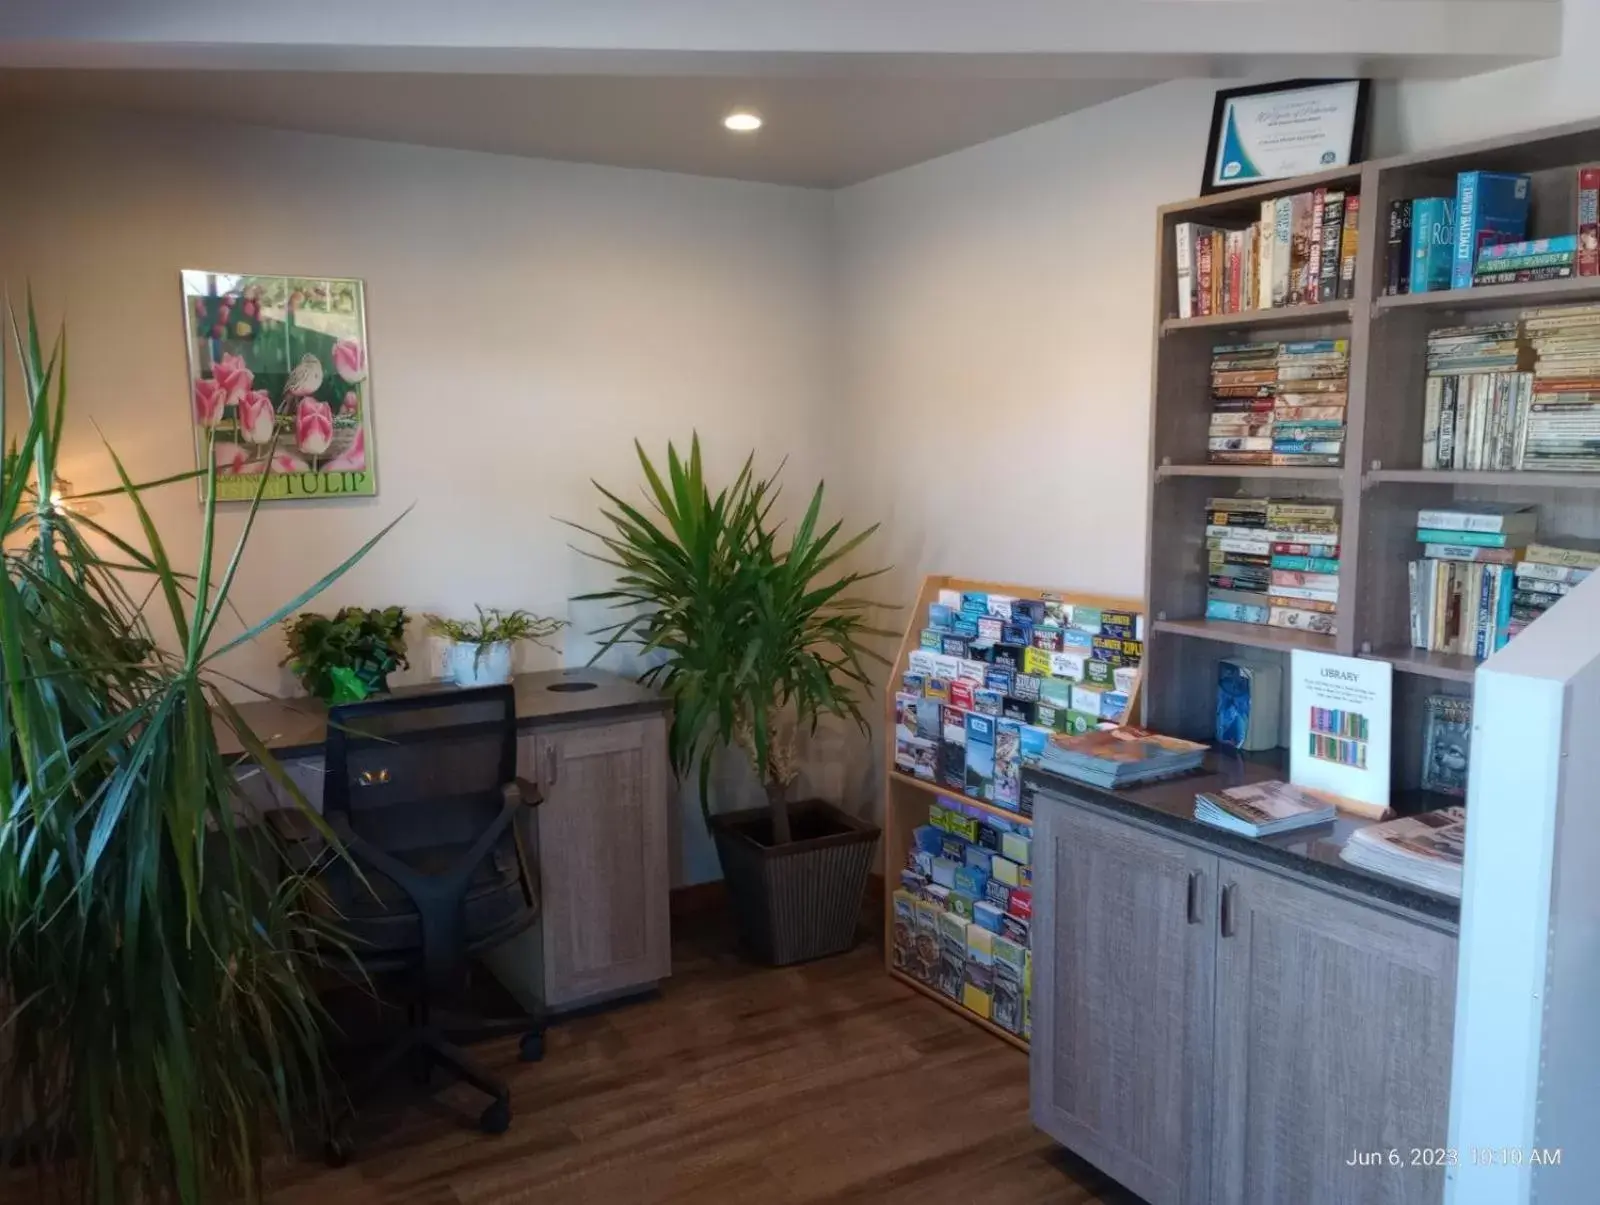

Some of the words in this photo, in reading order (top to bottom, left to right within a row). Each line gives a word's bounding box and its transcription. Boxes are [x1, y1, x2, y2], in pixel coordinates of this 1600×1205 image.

[1309, 244, 1321, 274] COBEN
[279, 471, 366, 495] TULIP
[1320, 668, 1360, 683] LIBRARY
